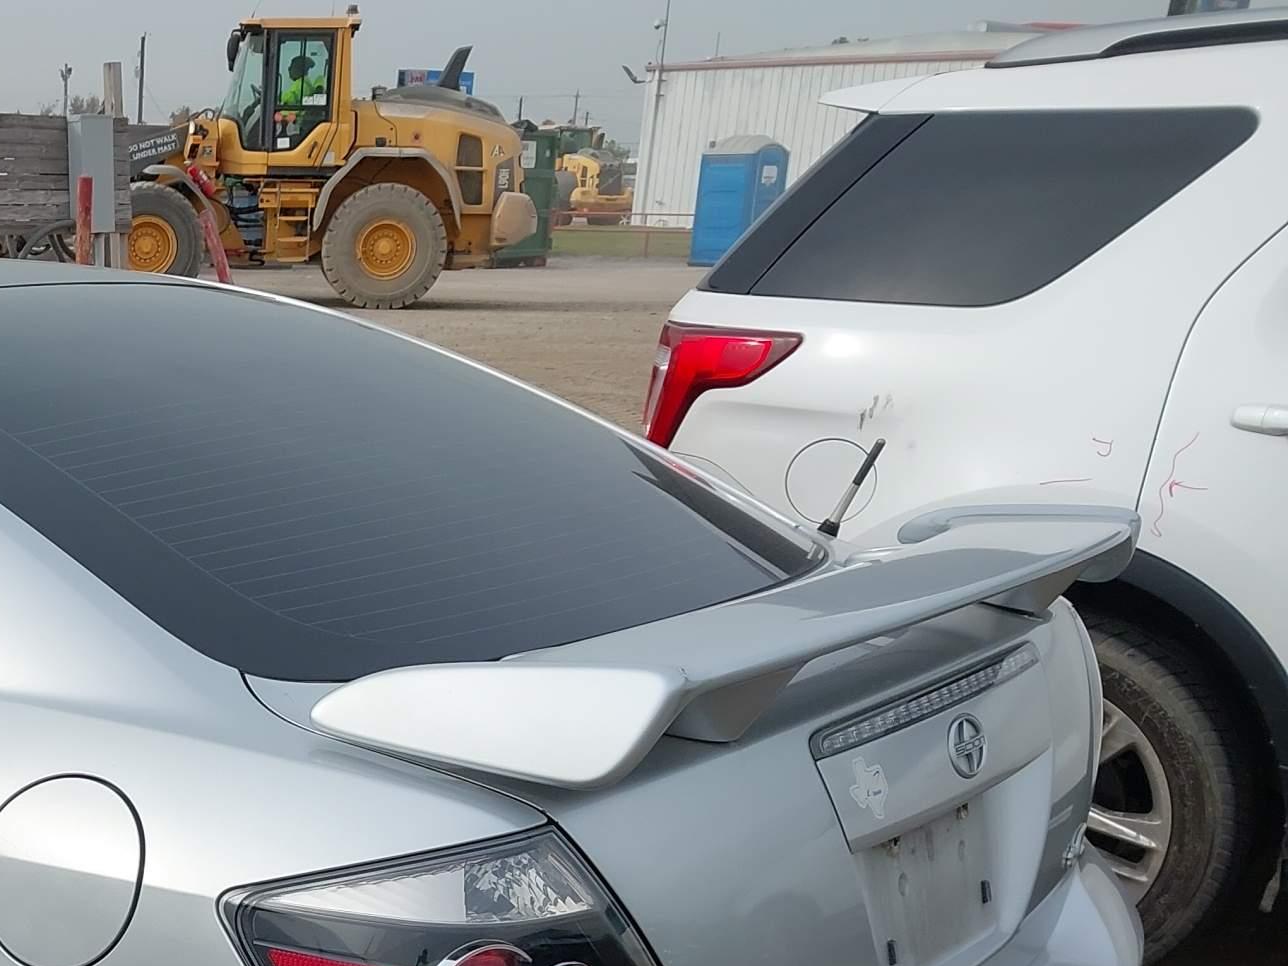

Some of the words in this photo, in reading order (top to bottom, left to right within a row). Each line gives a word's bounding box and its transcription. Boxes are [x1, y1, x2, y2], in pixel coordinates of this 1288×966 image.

[139, 139, 156, 149] NOT
[156, 133, 177, 143] WALK
[157, 143, 176, 153] MAST
